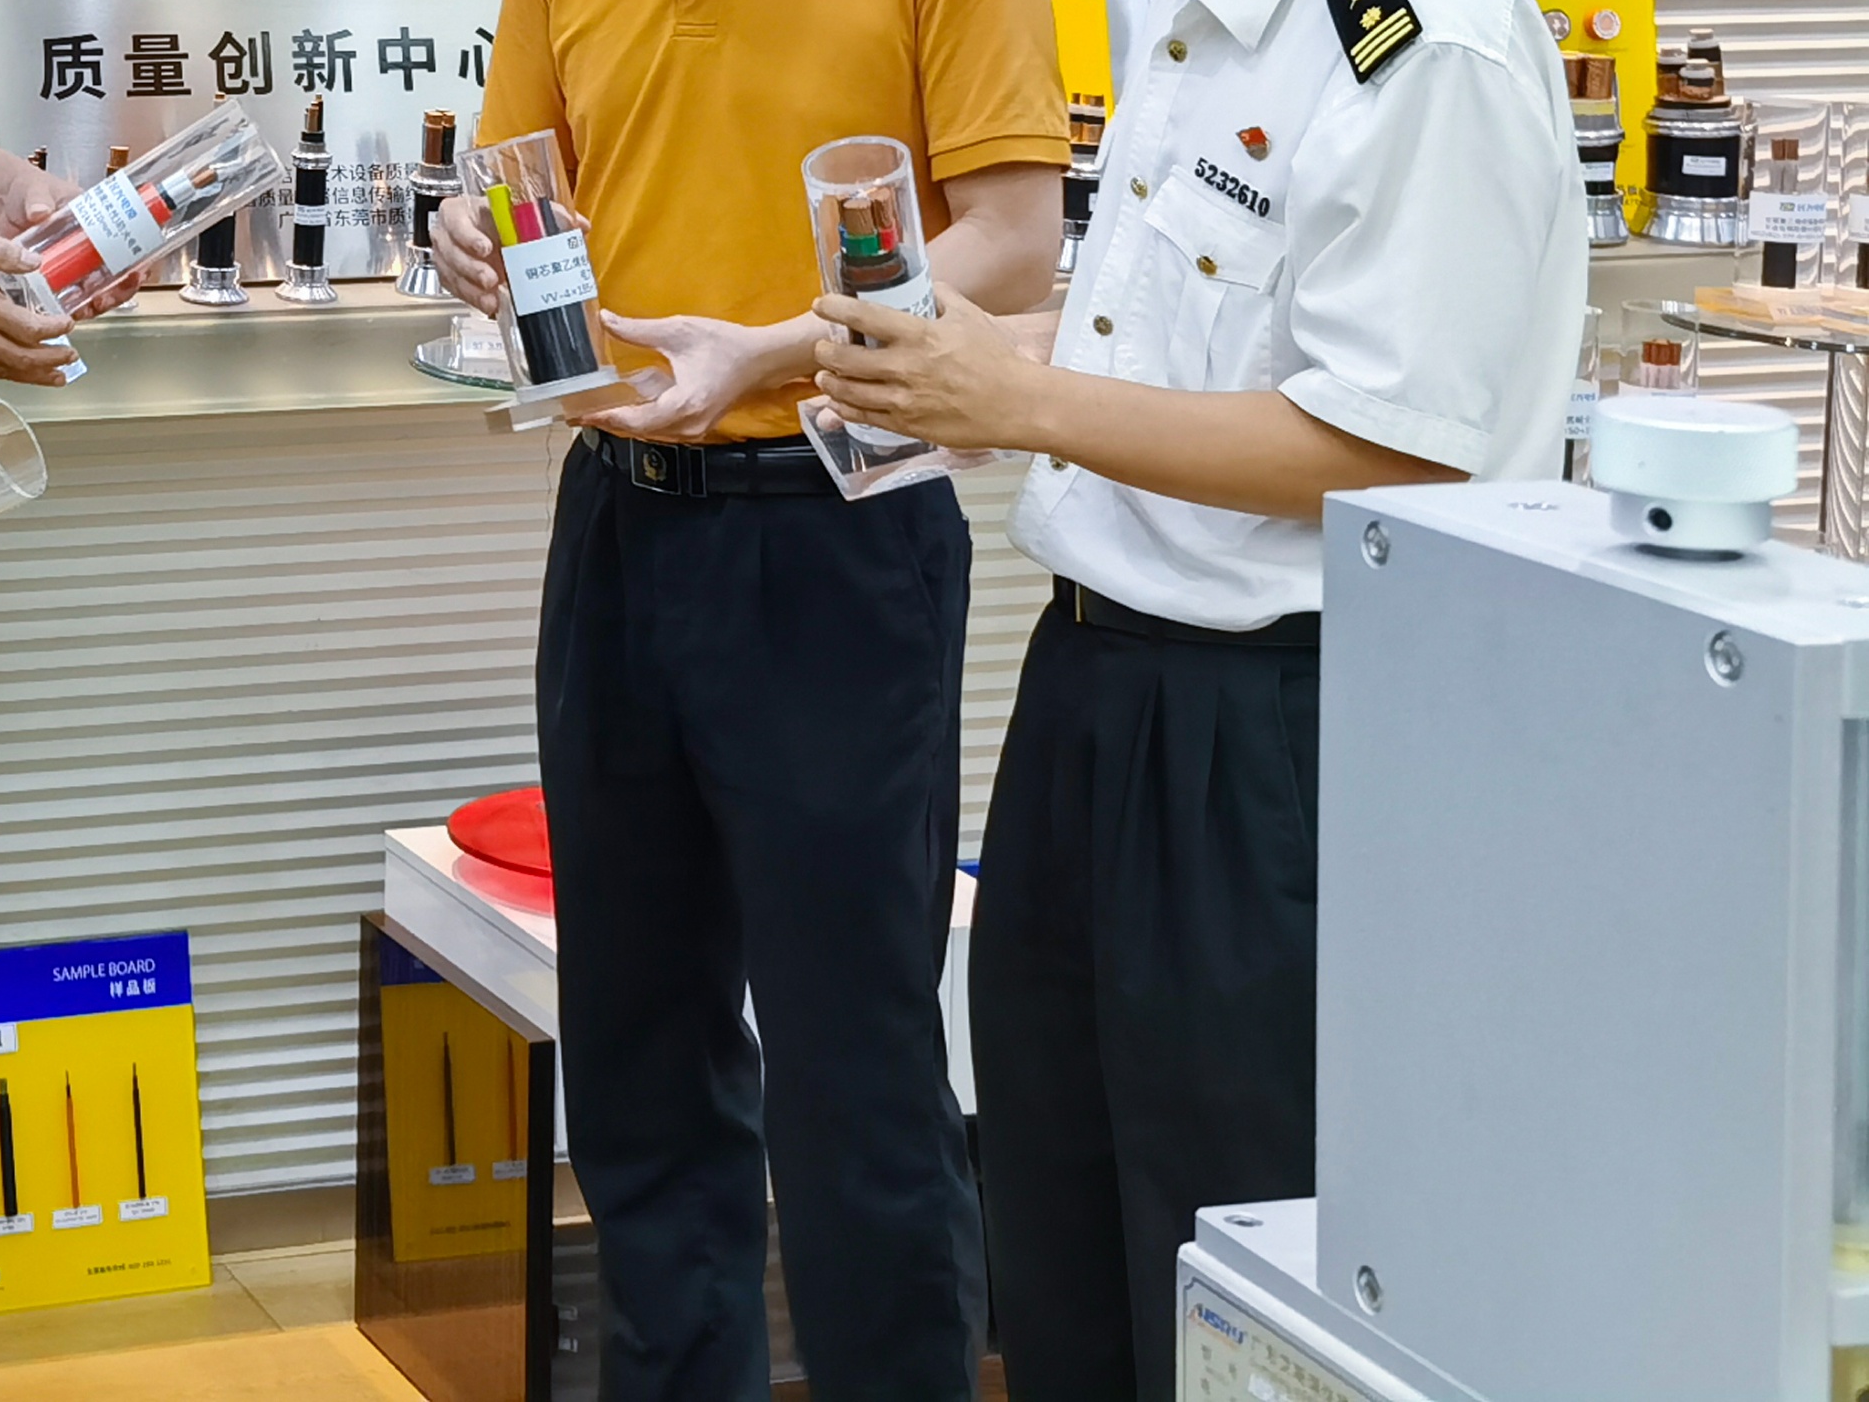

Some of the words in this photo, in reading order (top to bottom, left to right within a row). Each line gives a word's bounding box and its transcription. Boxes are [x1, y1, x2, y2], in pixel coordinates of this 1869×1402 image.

[1194, 157, 1270, 217] 5232610
[53, 962, 106, 982] SAMPLE
[108, 959, 155, 976] BOARD
[110, 978, 156, 998] 样品板
